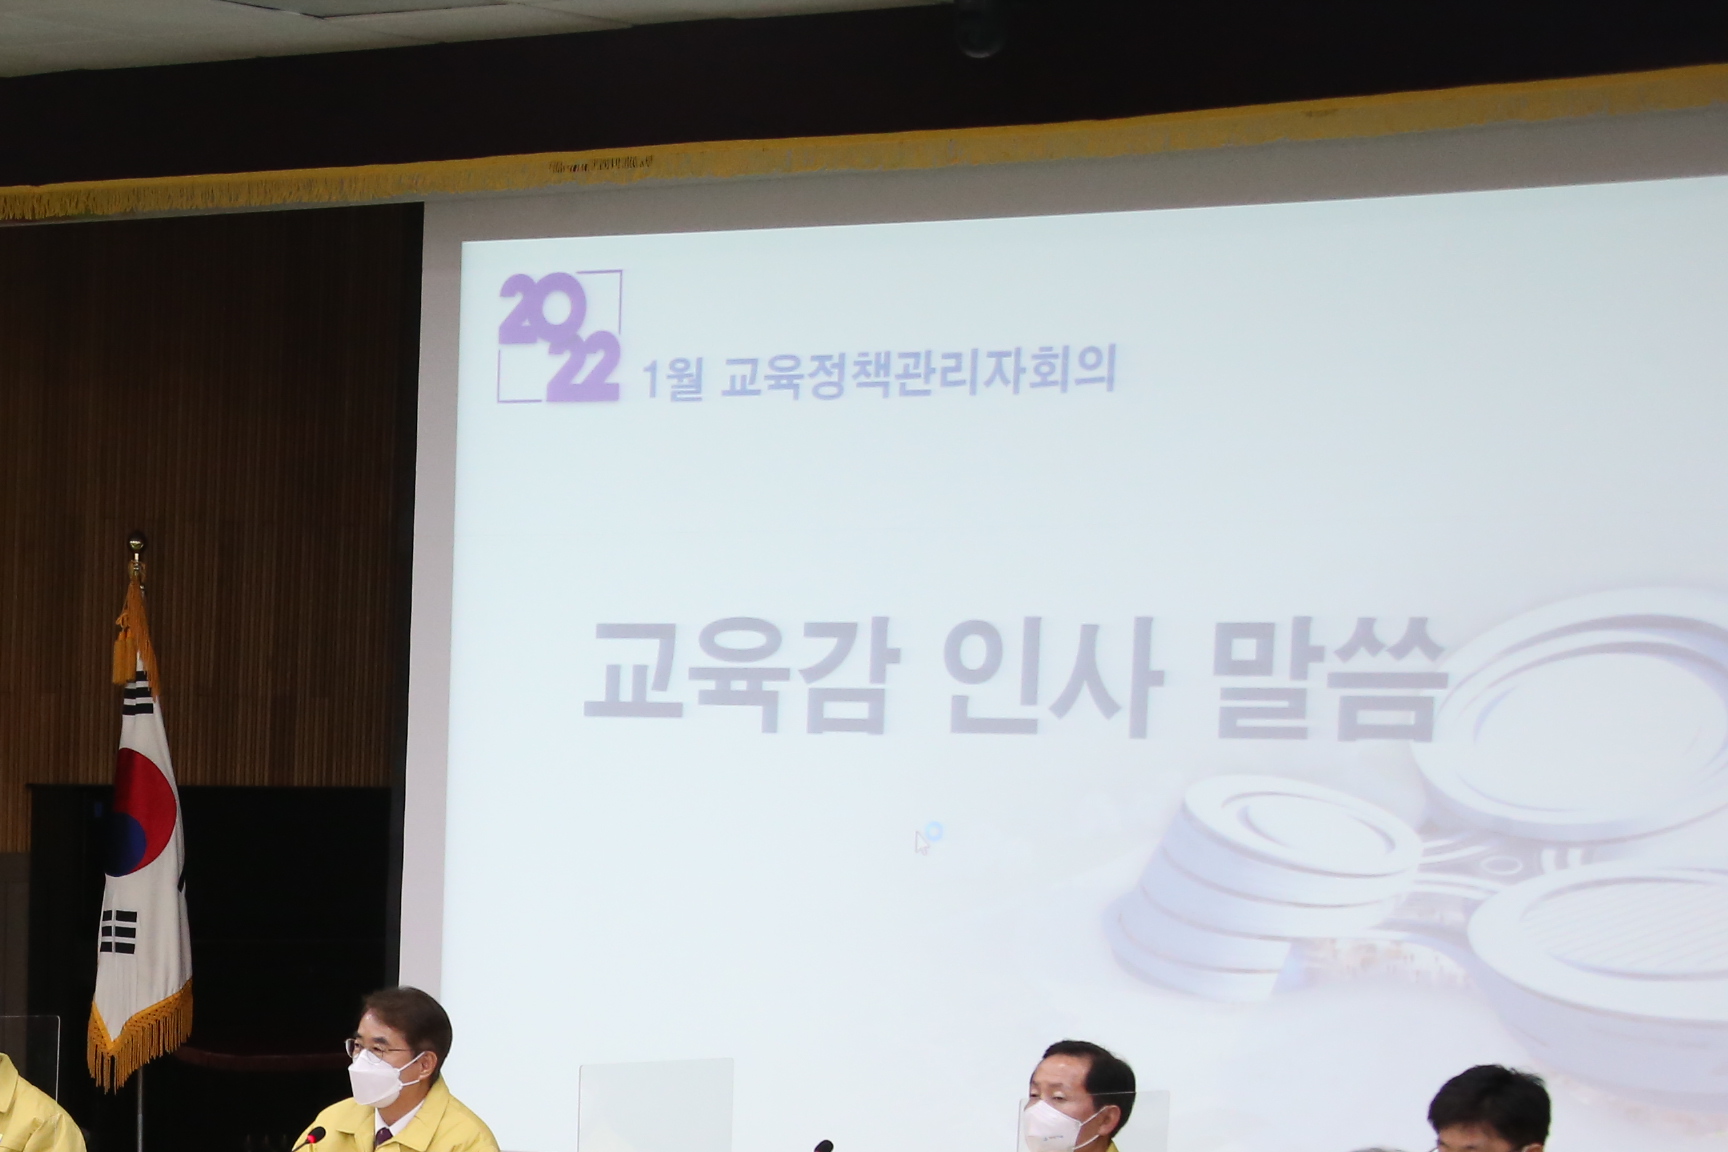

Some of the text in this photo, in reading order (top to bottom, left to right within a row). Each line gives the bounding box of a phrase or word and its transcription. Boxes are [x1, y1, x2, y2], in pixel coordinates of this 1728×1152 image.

[642, 343, 1119, 402] 1월 교육정책관리자회의
[583, 616, 1450, 743] 교육감 인사 말씀
